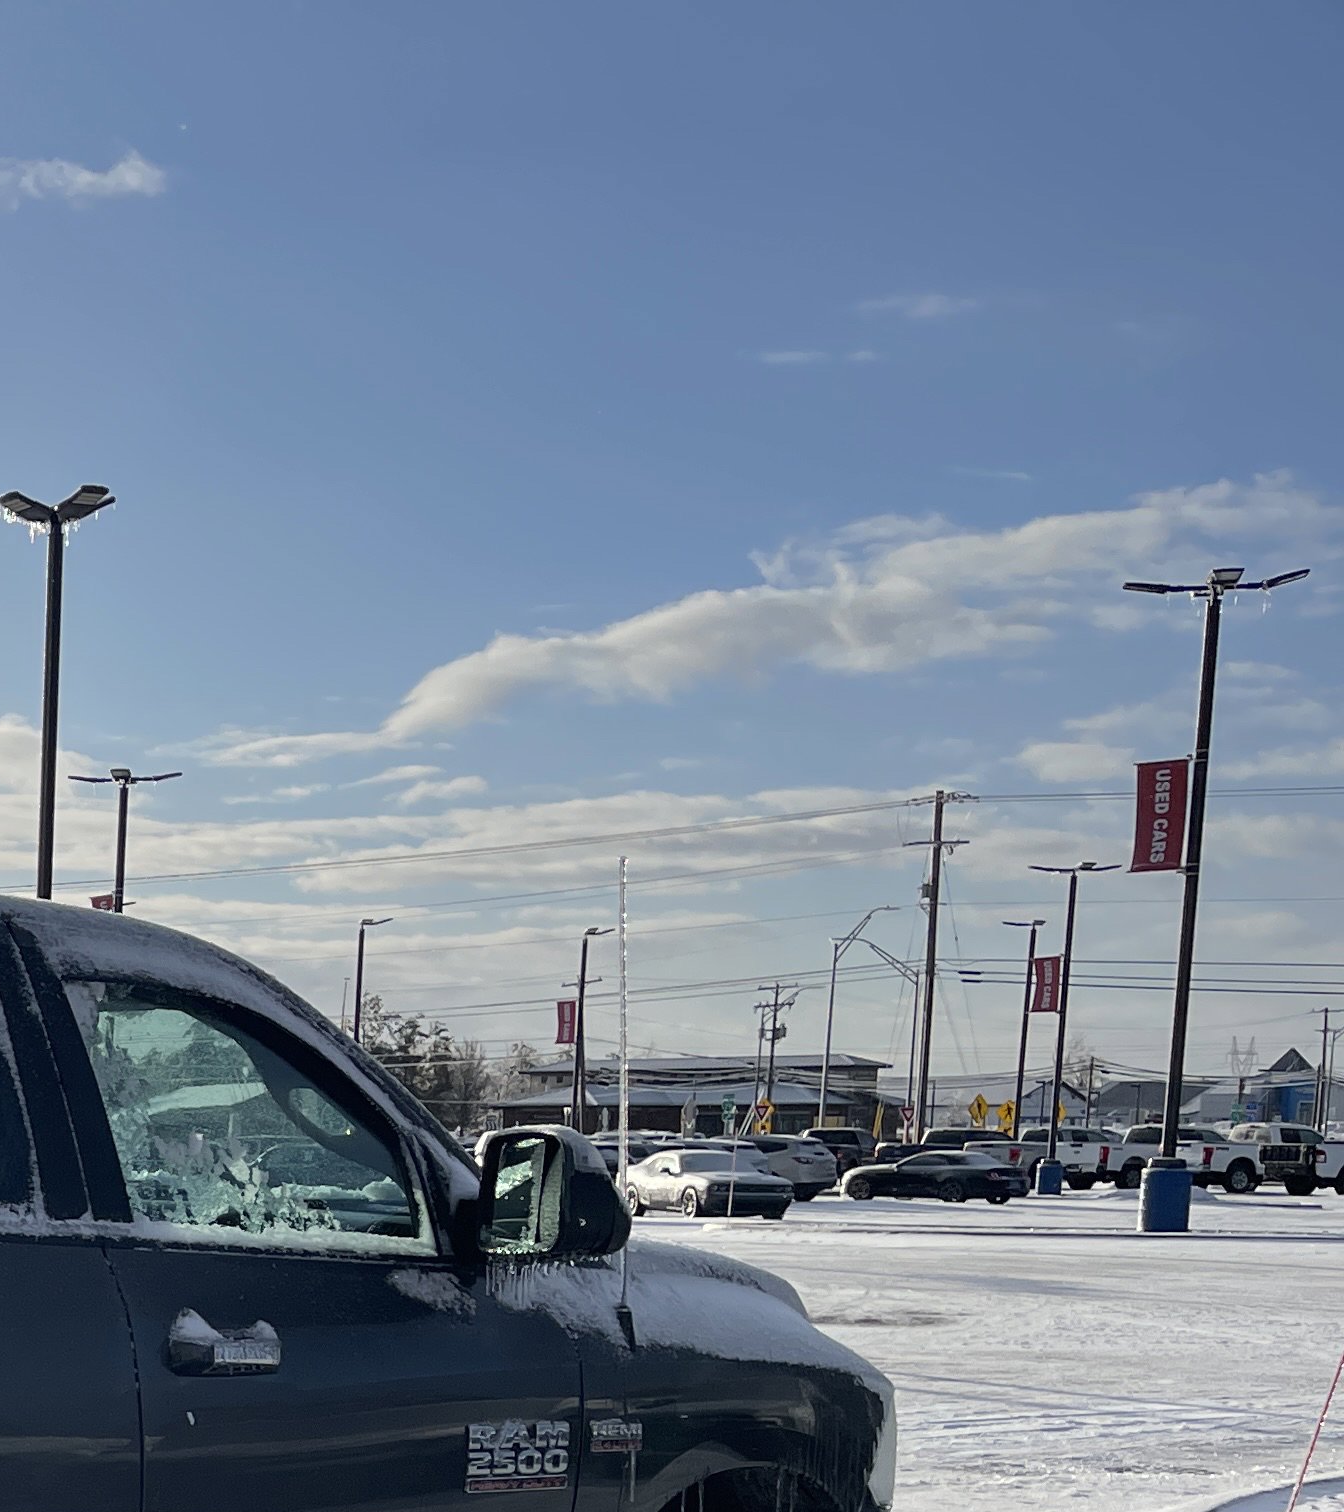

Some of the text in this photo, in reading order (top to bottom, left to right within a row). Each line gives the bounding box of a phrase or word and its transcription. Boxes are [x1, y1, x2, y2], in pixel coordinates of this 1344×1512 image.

[1150, 769, 1172, 863] USED CARS
[468, 1419, 570, 1450] RAM
[466, 1449, 569, 1476] 2500
